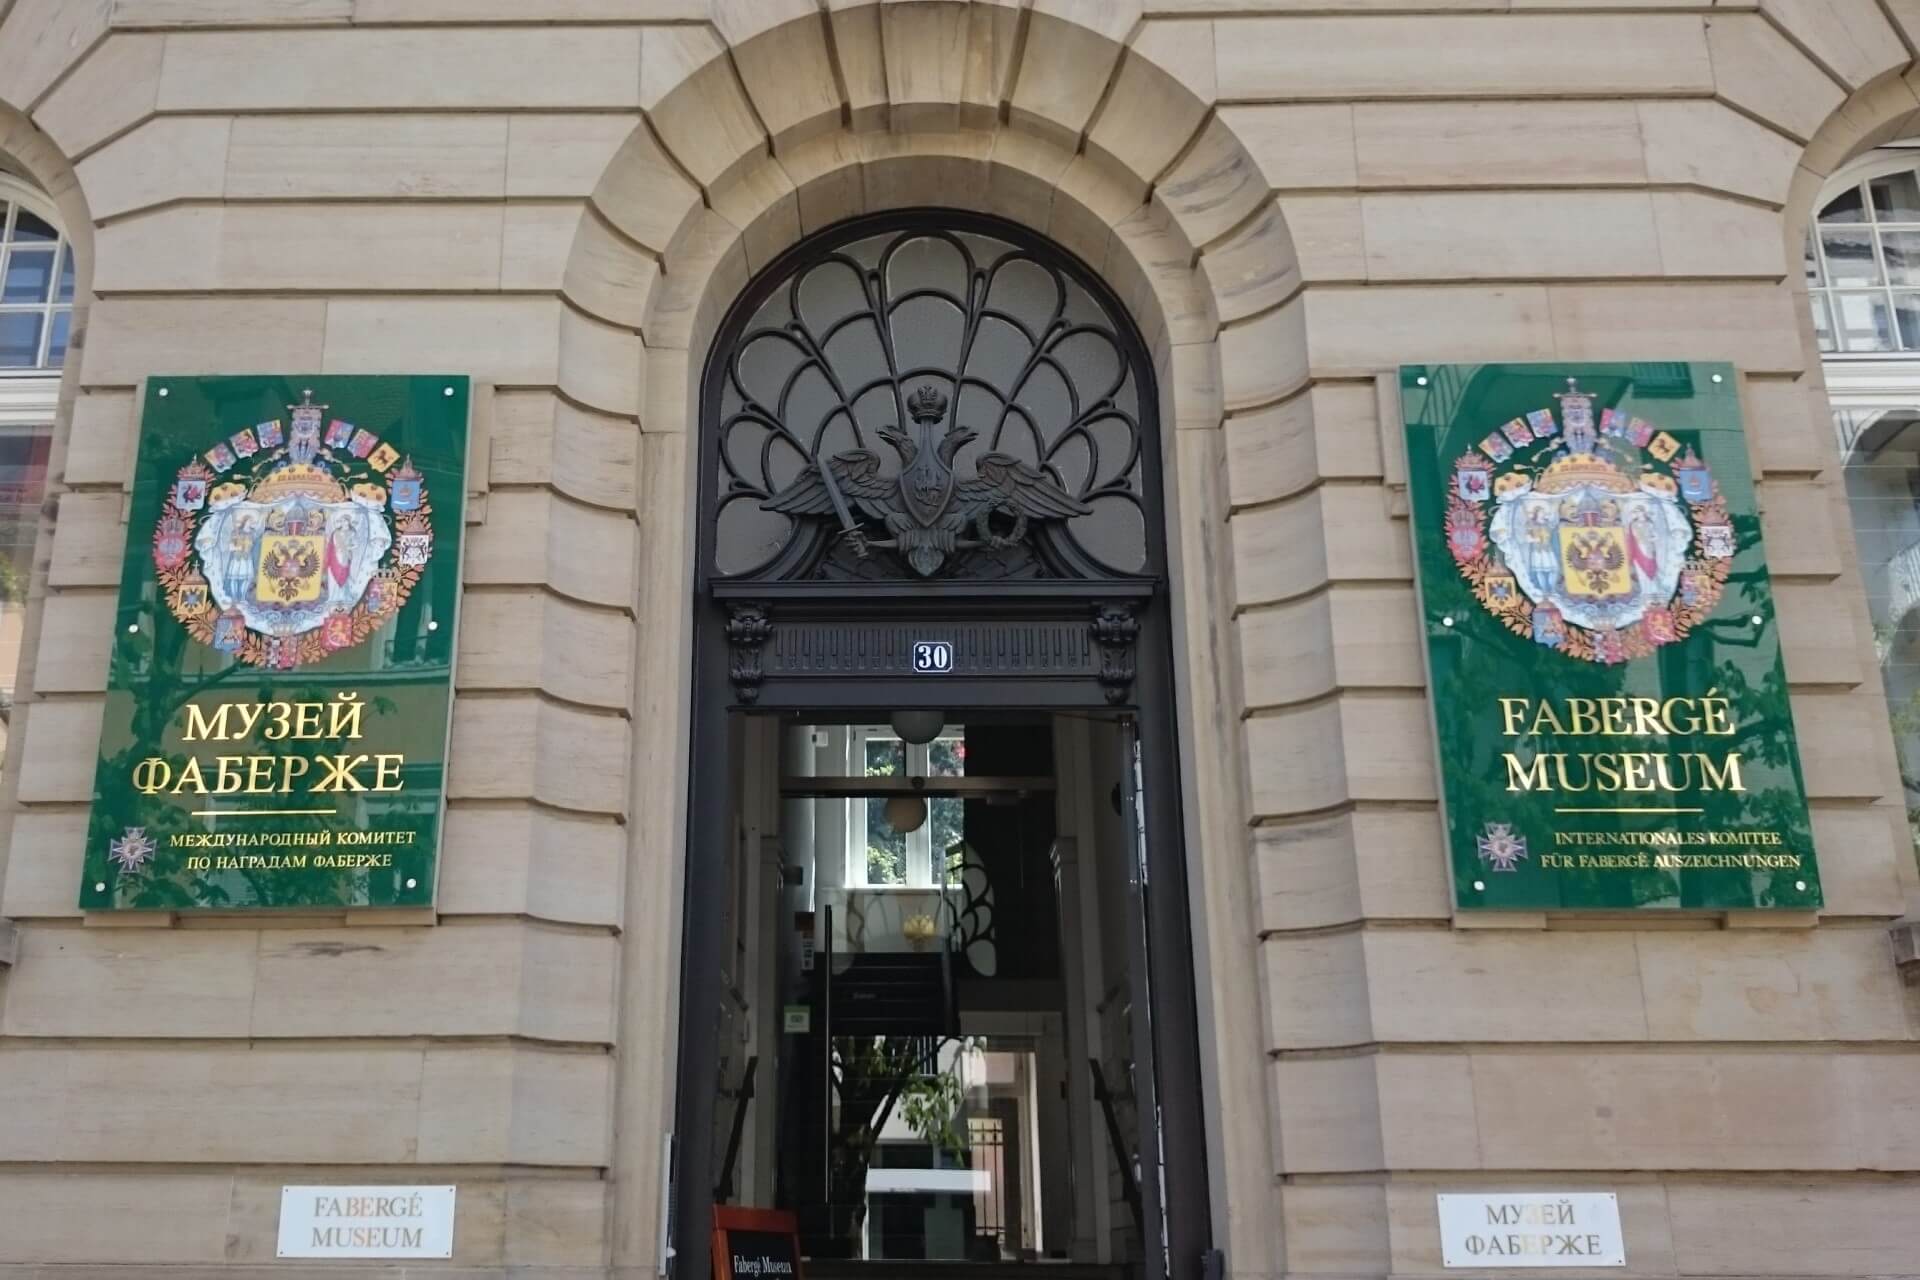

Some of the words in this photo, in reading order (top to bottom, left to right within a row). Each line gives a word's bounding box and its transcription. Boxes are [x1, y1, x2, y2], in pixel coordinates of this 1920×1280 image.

[918, 645, 948, 668] 30
[181, 691, 365, 740] МУЗЕЙ
[1499, 687, 1736, 736] FABERGÉ
[132, 754, 404, 795] ФАБЕРЖЕ
[1502, 753, 1747, 792] MUSEUM
[170, 829, 331, 848] МЕЖДУНАРОДНЫЙ
[336, 831, 417, 846] КОМИТЕТ
[1555, 832, 1705, 846] INTERNATIONALES
[1709, 832, 1782, 846] KOMITEE
[187, 856, 211, 870] ПО
[216, 855, 307, 870] НАГРАДАМ
[313, 854, 393, 869] ФАБЕРЖЕ
[1540, 853, 1575, 868] FÜR
[1653, 854, 1801, 869] AUSZEICHNUNGEN
[314, 1191, 423, 1217] FABERGÉ
[311, 1226, 424, 1248] MUSEUM
[1465, 1234, 1603, 1255] ФАБЕРЖЕ
